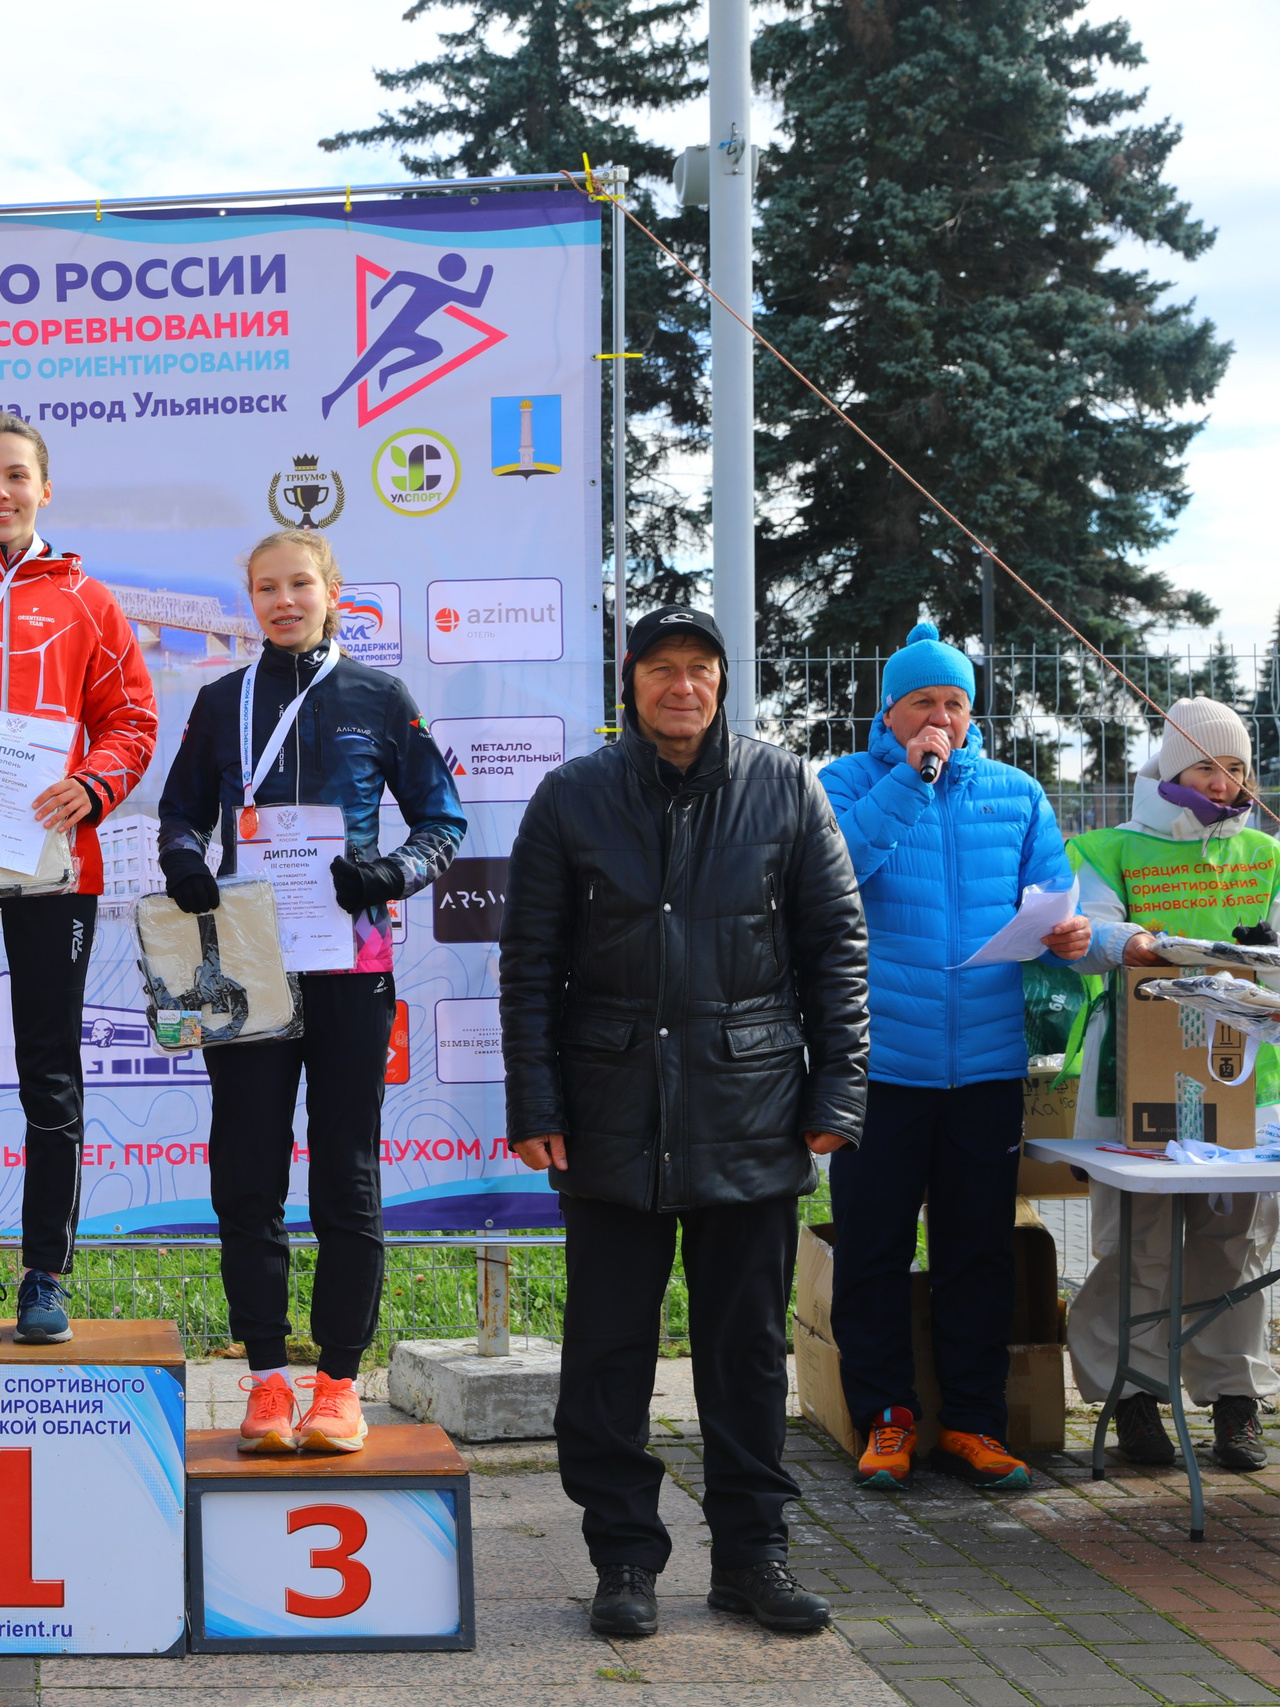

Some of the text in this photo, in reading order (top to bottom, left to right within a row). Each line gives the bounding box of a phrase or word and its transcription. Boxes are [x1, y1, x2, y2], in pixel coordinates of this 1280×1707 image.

[55, 254, 287, 303] РОССИИ
[37, 349, 289, 379] ОРИЕНТИРОВАНИЯ
[38, 400, 127, 427] город
[132, 391, 287, 418] Ульяновск
[284, 473, 328, 482] ТРИУМФ
[390, 492, 442, 503] УЛСПОРТ
[466, 602, 556, 624] azimut
[365, 653, 401, 661] ПРОЕКТОВ
[471, 742, 532, 752] МЕТАЛЛО
[472, 751, 562, 763] ПРОФИЛЬНЫЙ
[472, 766, 514, 776] ЗАВОД
[263, 848, 318, 860] ДИПЛОМ
[1123, 863, 1189, 880] дерация
[1221, 1065, 1233, 1073] 12
[1142, 1112, 1156, 1132] L
[4, 1378, 145, 1393] СПОРТИВНОГО
[42, 1420, 131, 1435] ОБЛАСТИ
[285, 1503, 372, 1619] 3
